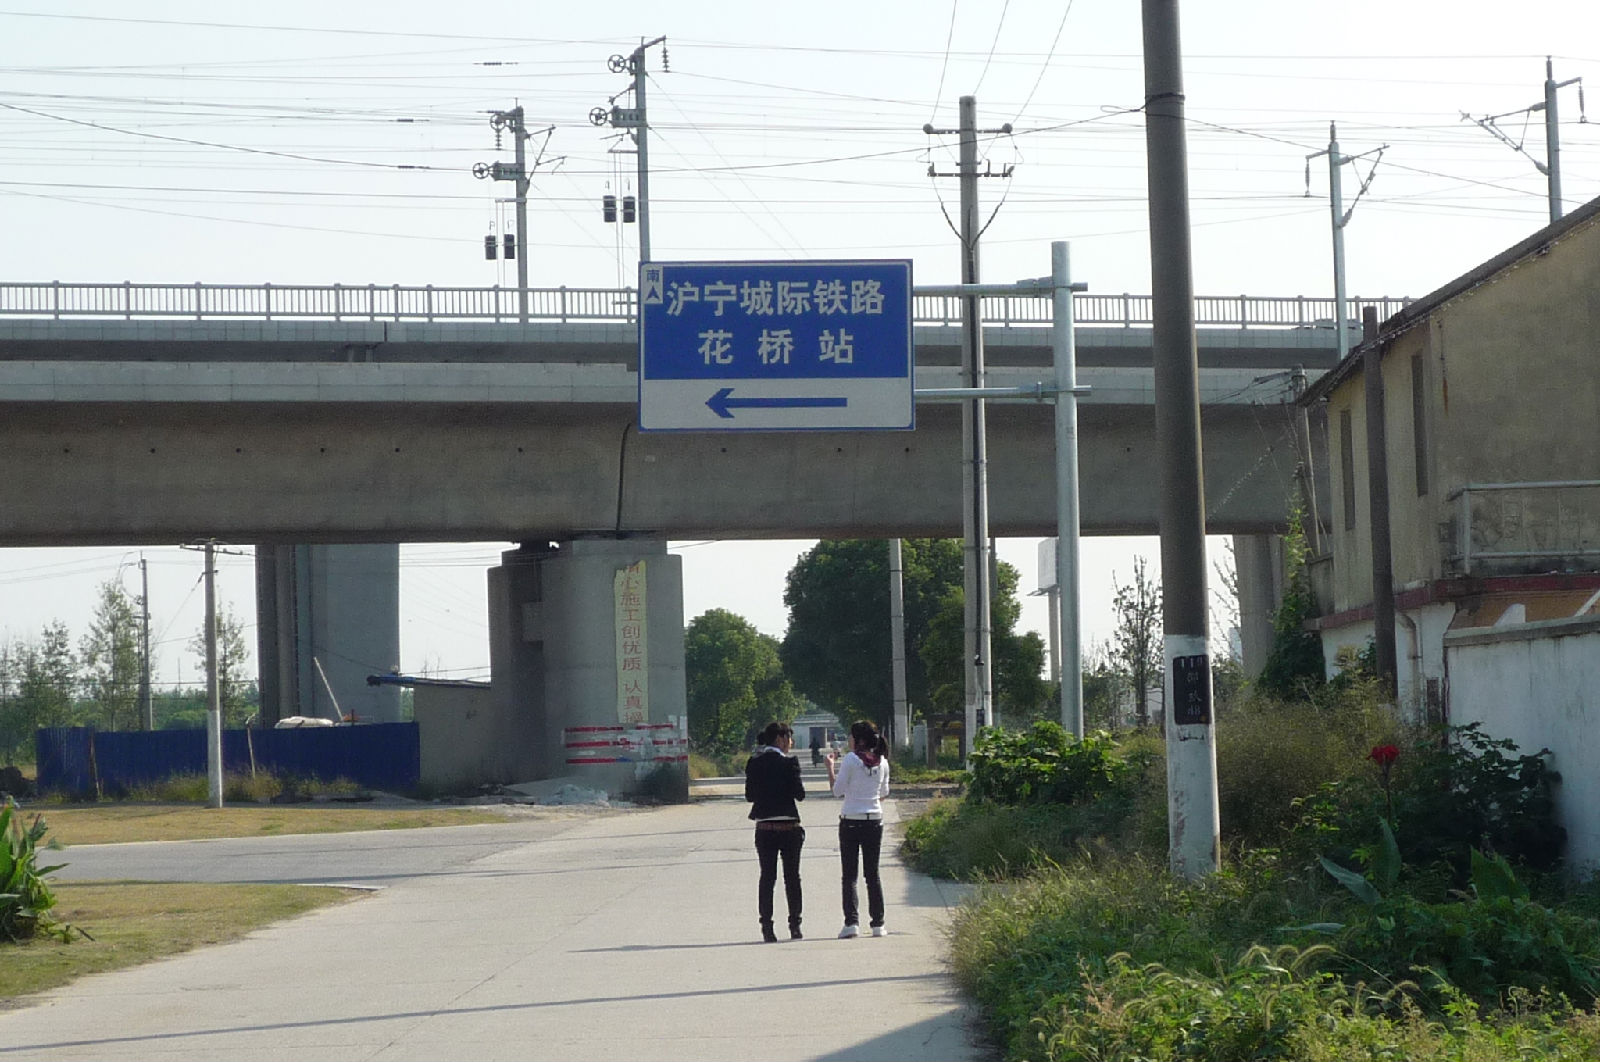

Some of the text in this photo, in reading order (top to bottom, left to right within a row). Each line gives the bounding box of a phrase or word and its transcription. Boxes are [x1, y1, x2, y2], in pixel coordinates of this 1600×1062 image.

[645, 269, 660, 282] 南
[666, 279, 886, 316] 沪宁城际铁路
[697, 328, 855, 365] 花桥站
